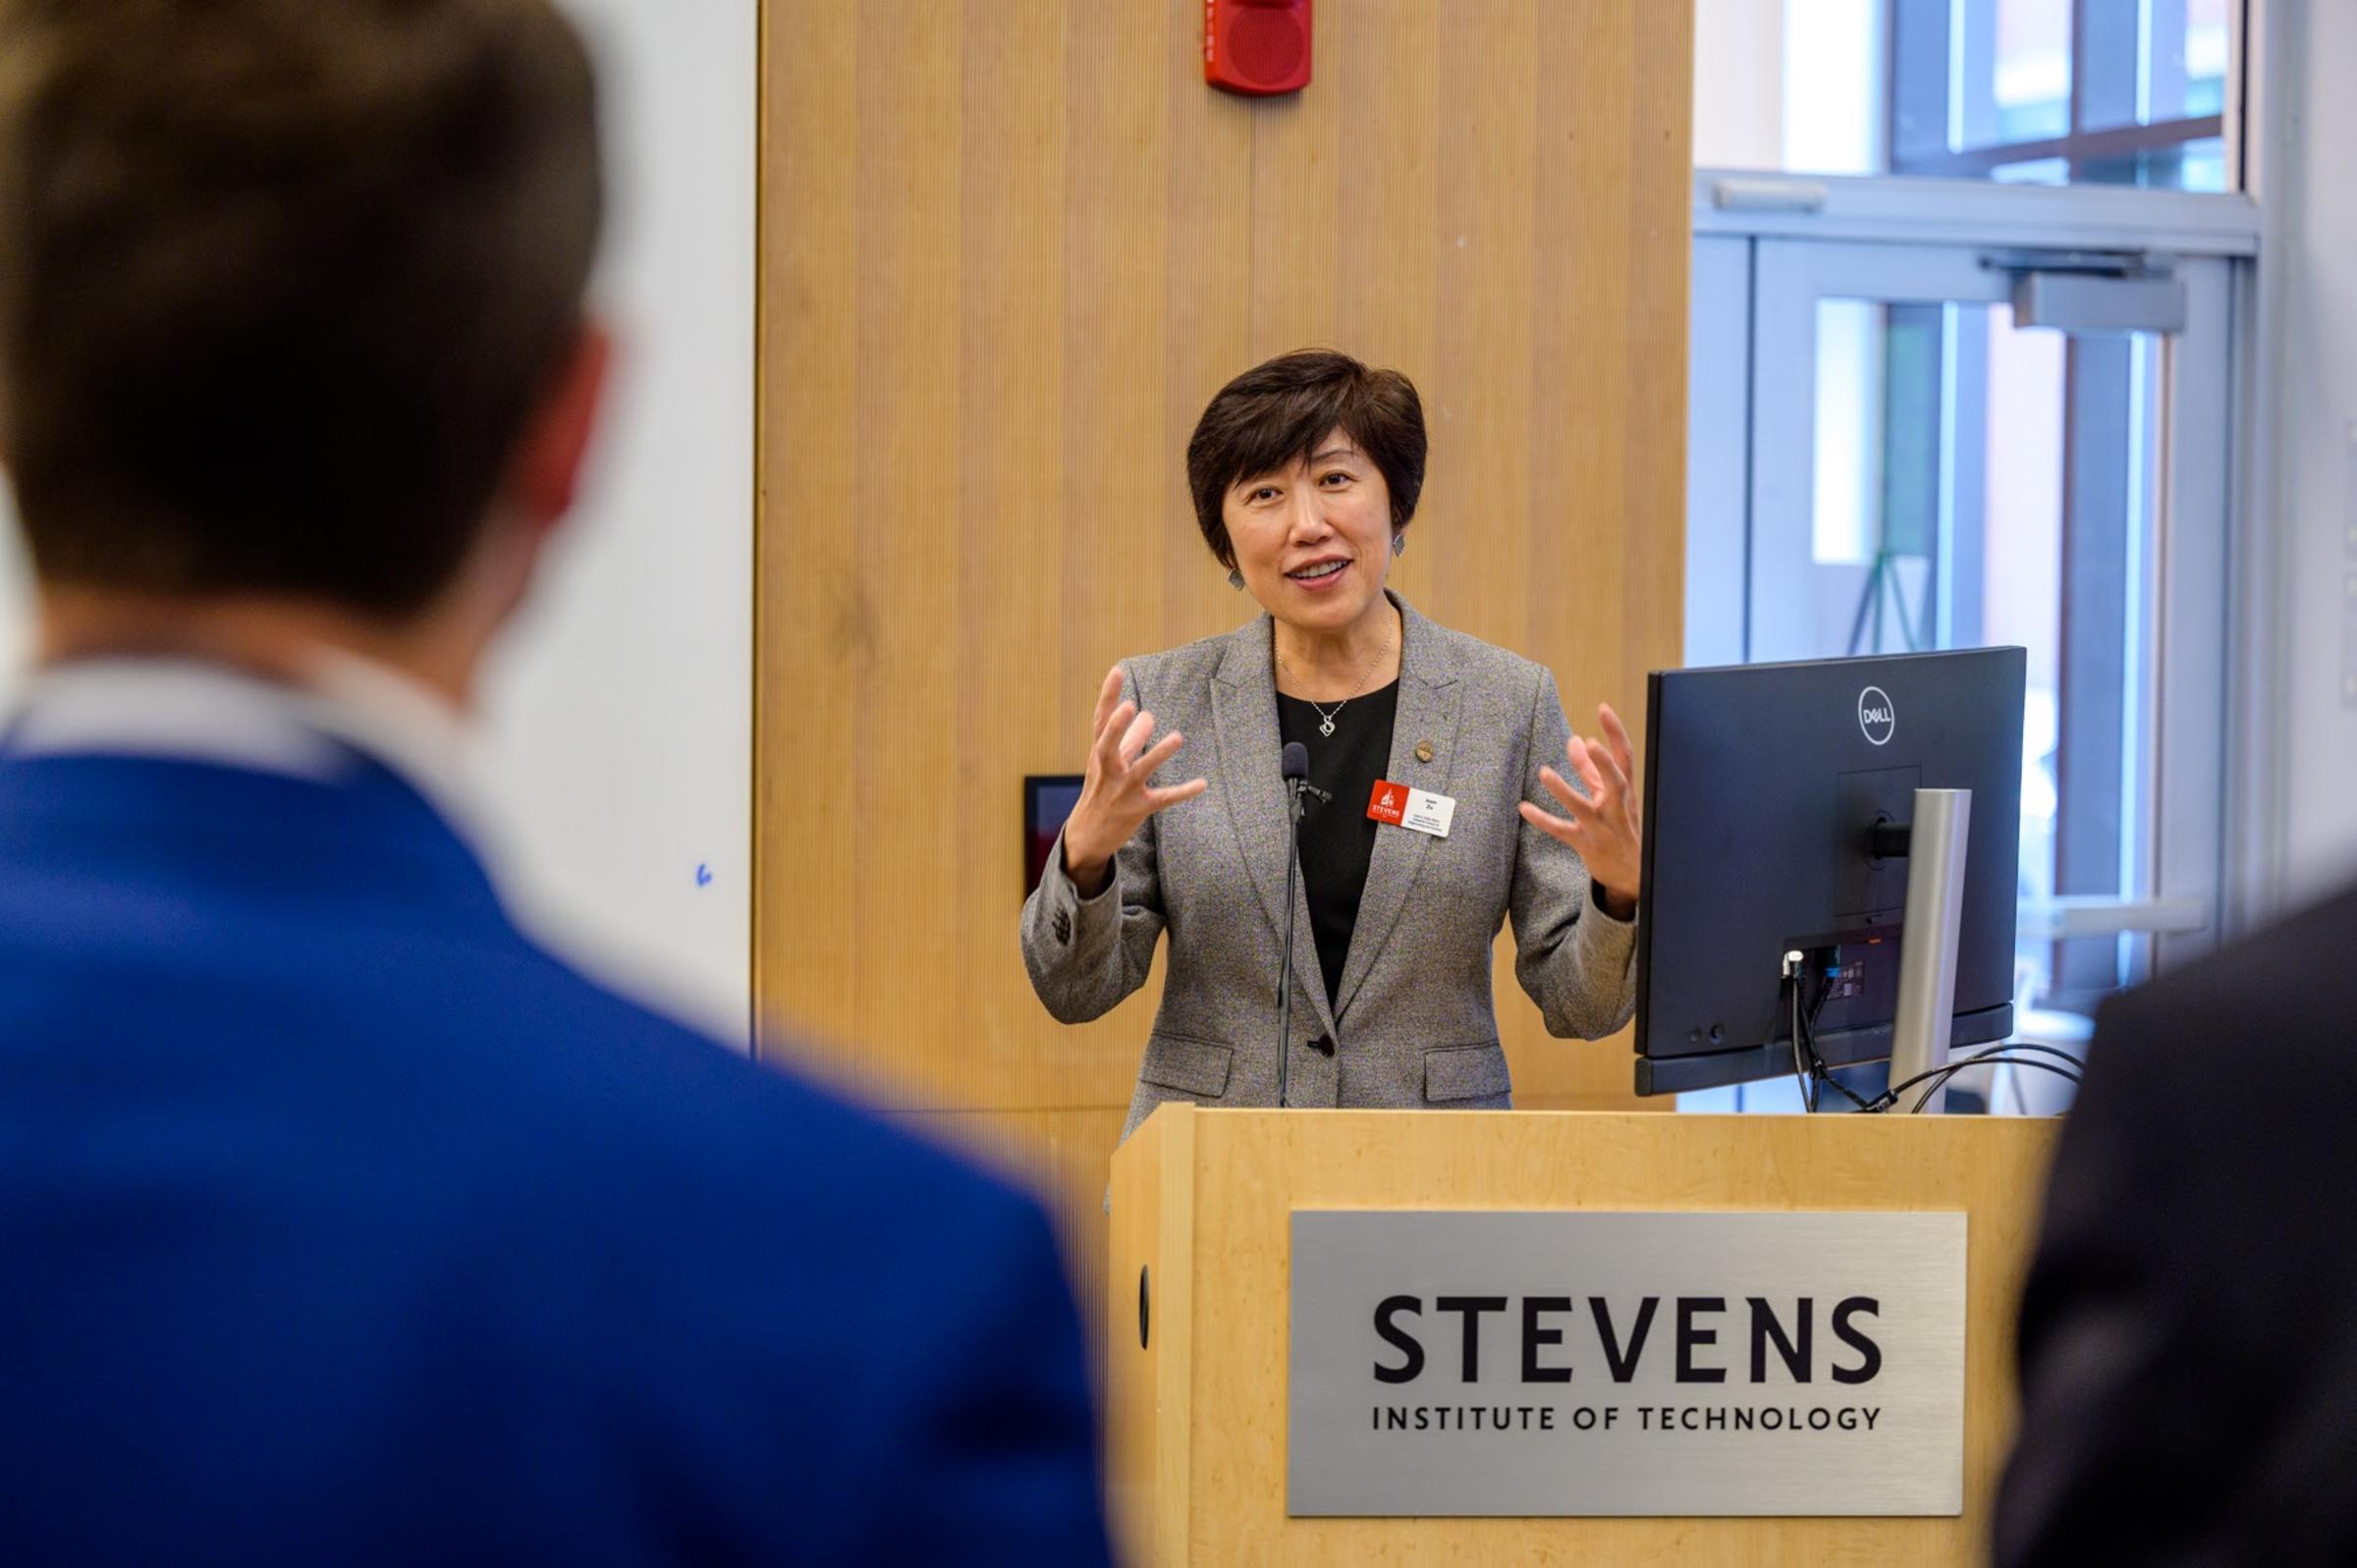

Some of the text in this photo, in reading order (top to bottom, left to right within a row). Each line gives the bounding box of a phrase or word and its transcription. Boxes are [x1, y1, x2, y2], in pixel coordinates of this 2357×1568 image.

[1863, 707, 1891, 724] DELL
[1373, 804, 1399, 818] STEVENS
[1373, 1295, 1882, 1385] STEVENS
[1372, 1406, 1881, 1431] INSTITUTE OF TECHNOLOGY
